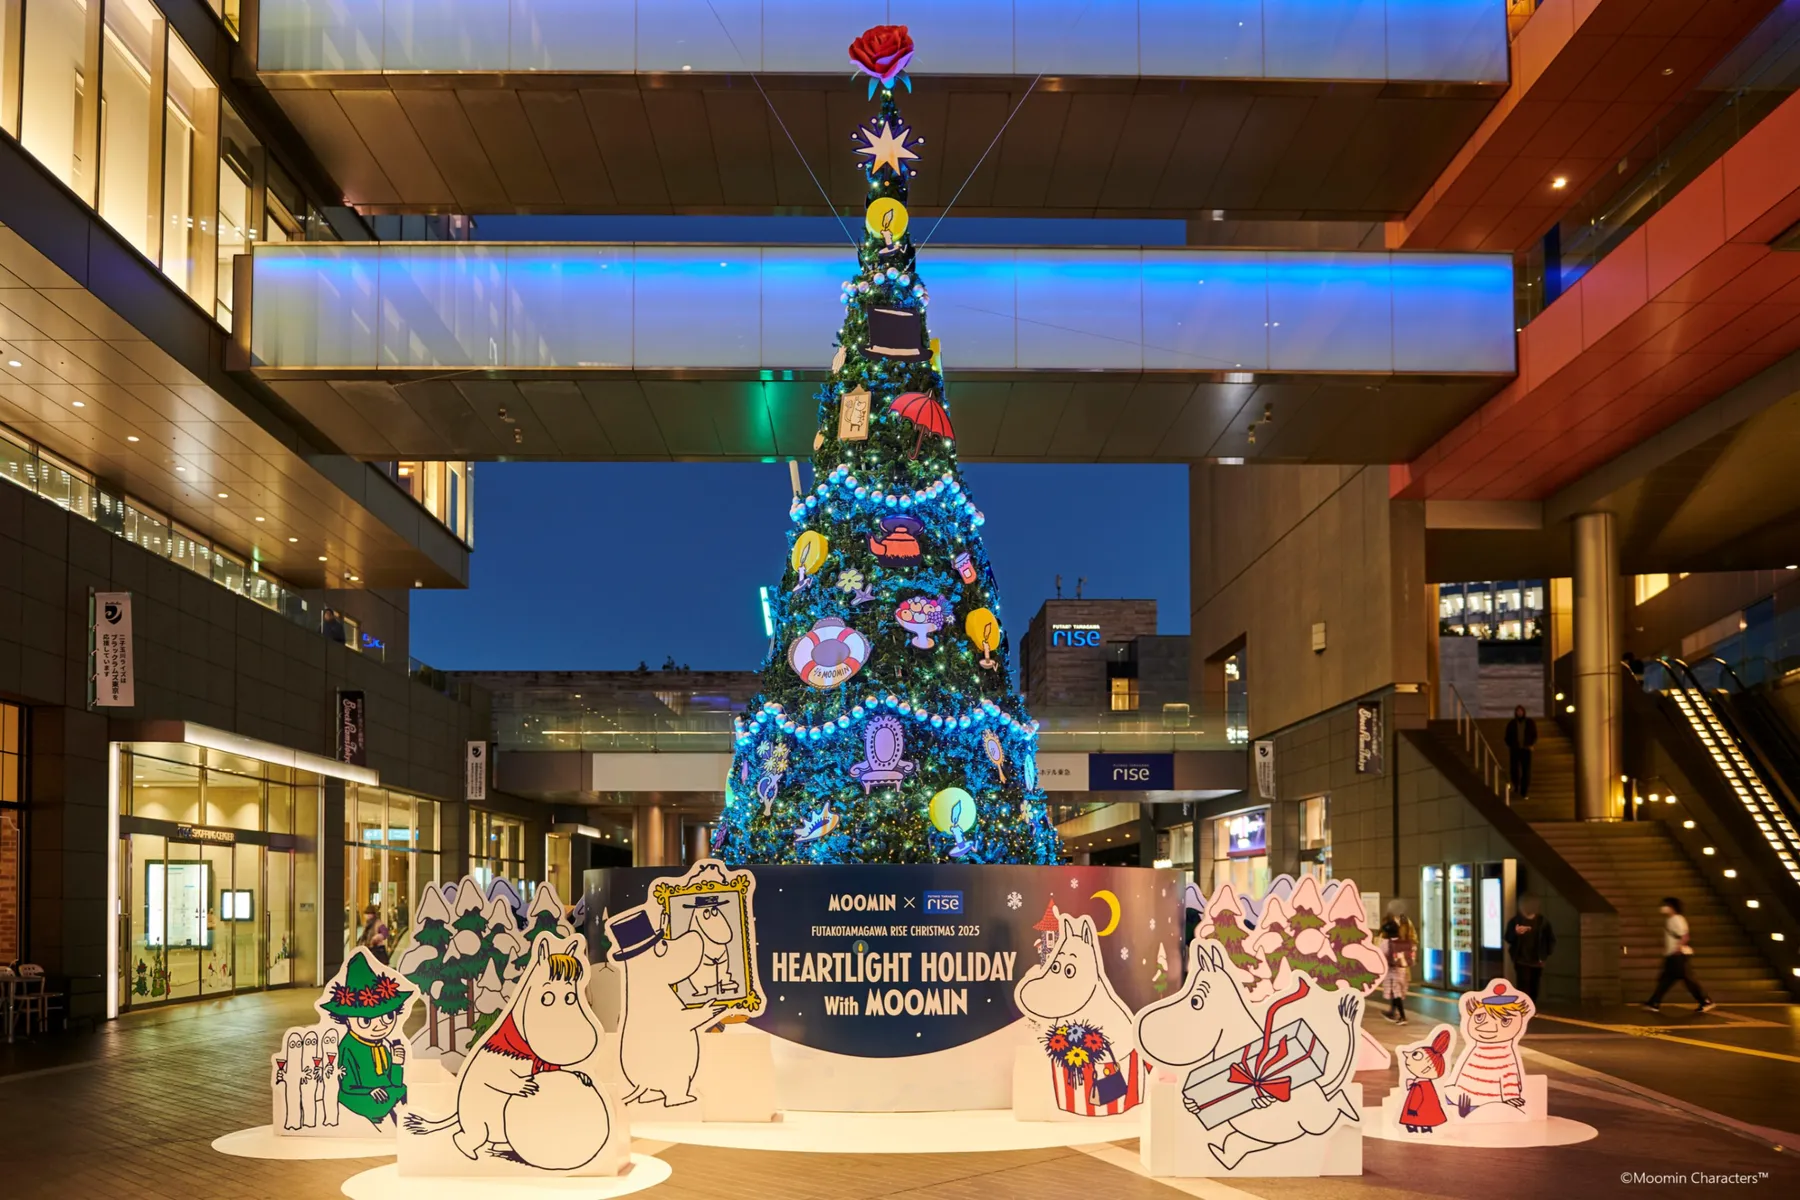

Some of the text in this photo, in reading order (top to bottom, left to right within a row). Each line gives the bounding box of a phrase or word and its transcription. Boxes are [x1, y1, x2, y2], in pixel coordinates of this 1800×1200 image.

[1053, 630, 1101, 647] rise
[822, 666, 850, 678] MOOMIN
[1113, 768, 1150, 781] rise
[828, 894, 896, 911] MOOMIN
[927, 899, 959, 910] rise
[811, 925, 980, 937] FUTAKOTAMAGAWA RISE CHRISTMAS 2025
[772, 951, 1017, 983] HEARTLIGHT HOLIDAY
[824, 988, 968, 1016] With MOOMIN
